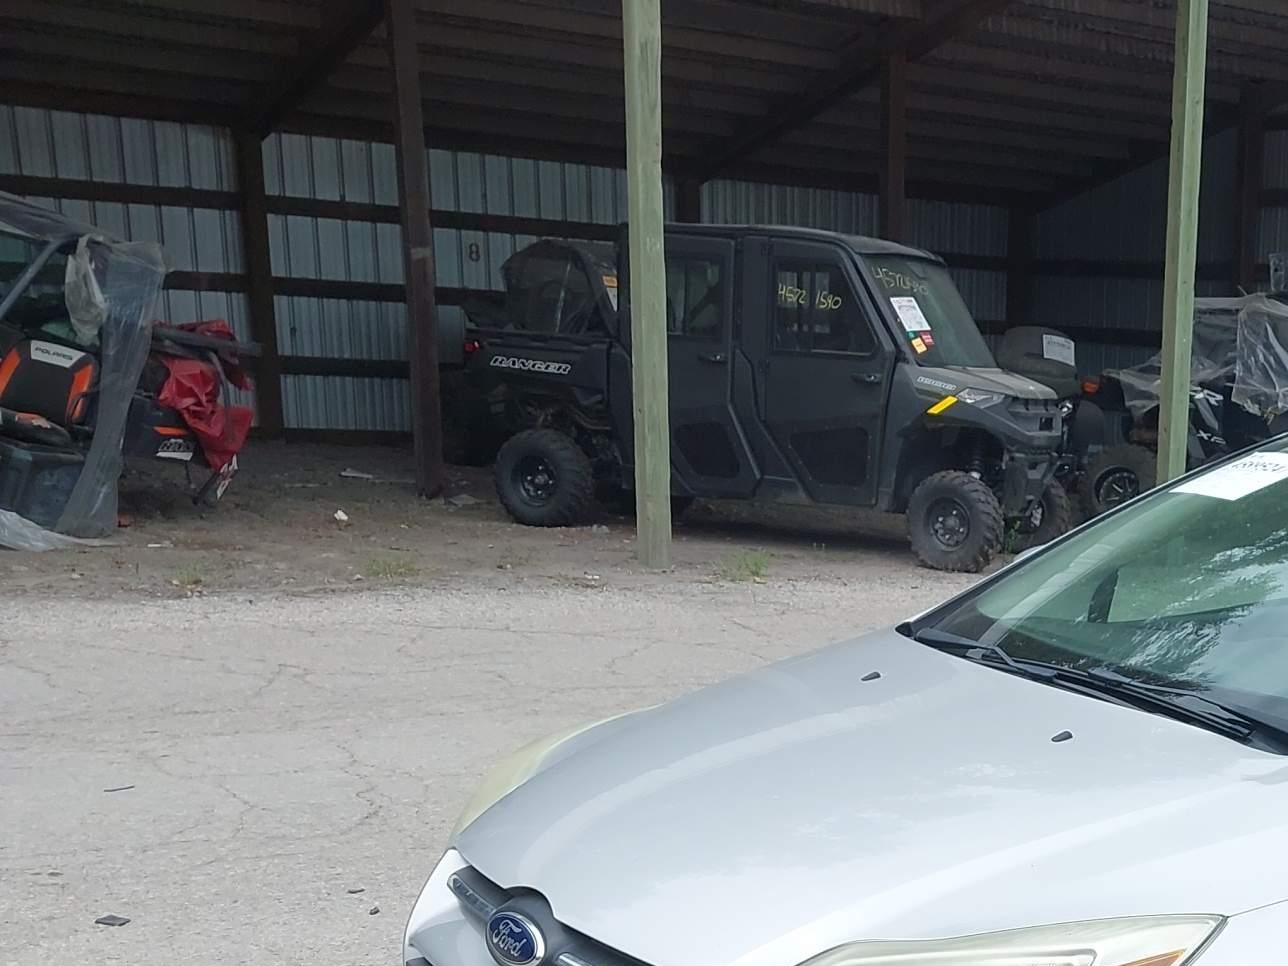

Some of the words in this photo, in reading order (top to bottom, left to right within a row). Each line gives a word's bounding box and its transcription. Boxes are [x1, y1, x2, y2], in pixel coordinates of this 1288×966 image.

[468, 242, 481, 262] 8
[490, 355, 572, 375] RANGER
[492, 919, 528, 957] Ford
